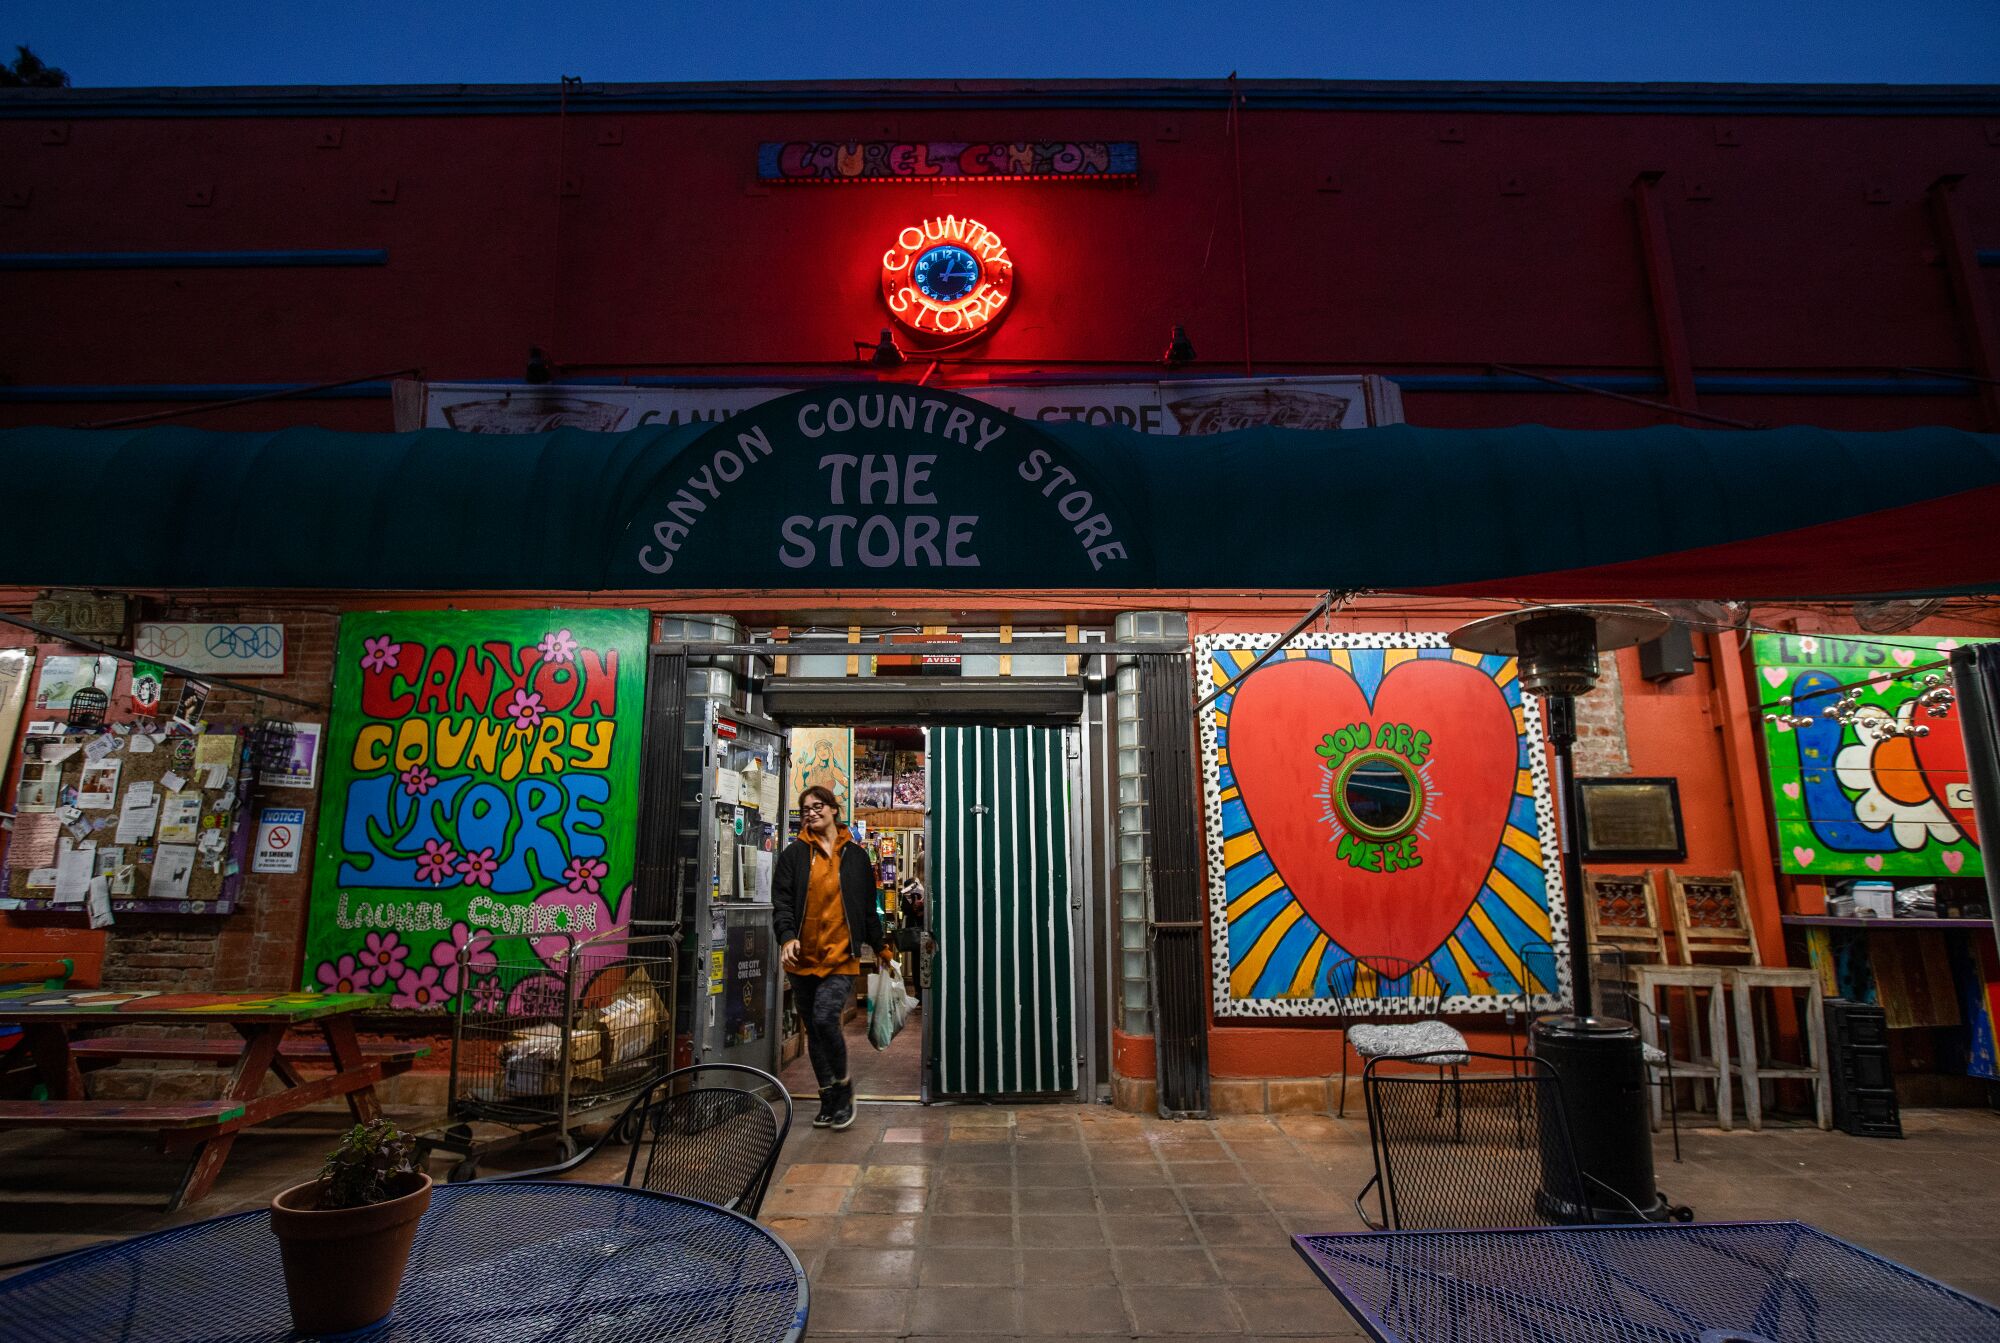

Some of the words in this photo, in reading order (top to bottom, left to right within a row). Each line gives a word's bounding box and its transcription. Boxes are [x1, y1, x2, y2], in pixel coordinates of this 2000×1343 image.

[779, 142, 942, 176] LAUREL
[958, 141, 1109, 174] CANYON
[883, 214, 1013, 270] COUNTRY
[943, 250, 952, 259] 12
[967, 261, 973, 269] 2
[918, 274, 925, 282] 9
[920, 262, 929, 270] 10
[890, 283, 1007, 332] STORE
[637, 425, 774, 574] CANYON
[798, 395, 1007, 453] COUNTRY
[1018, 449, 1128, 571] STORE
[818, 453, 939, 505] THE
[778, 514, 981, 569] STORE
[362, 641, 619, 719] CANYON
[352, 716, 617, 782] COUNTRY
[1315, 722, 1372, 769] YOU
[1375, 723, 1432, 765] ARE
[264, 811, 301, 822] NOTICE
[337, 773, 610, 894] STORE
[1336, 832, 1423, 873] HERE
[335, 893, 453, 932] LAUREL
[467, 895, 598, 942] CANYON
[737, 961, 748, 970] ONE
[749, 960, 760, 969] CITY
[737, 970, 748, 979] ONE
[748, 969, 762, 978] GOAL
